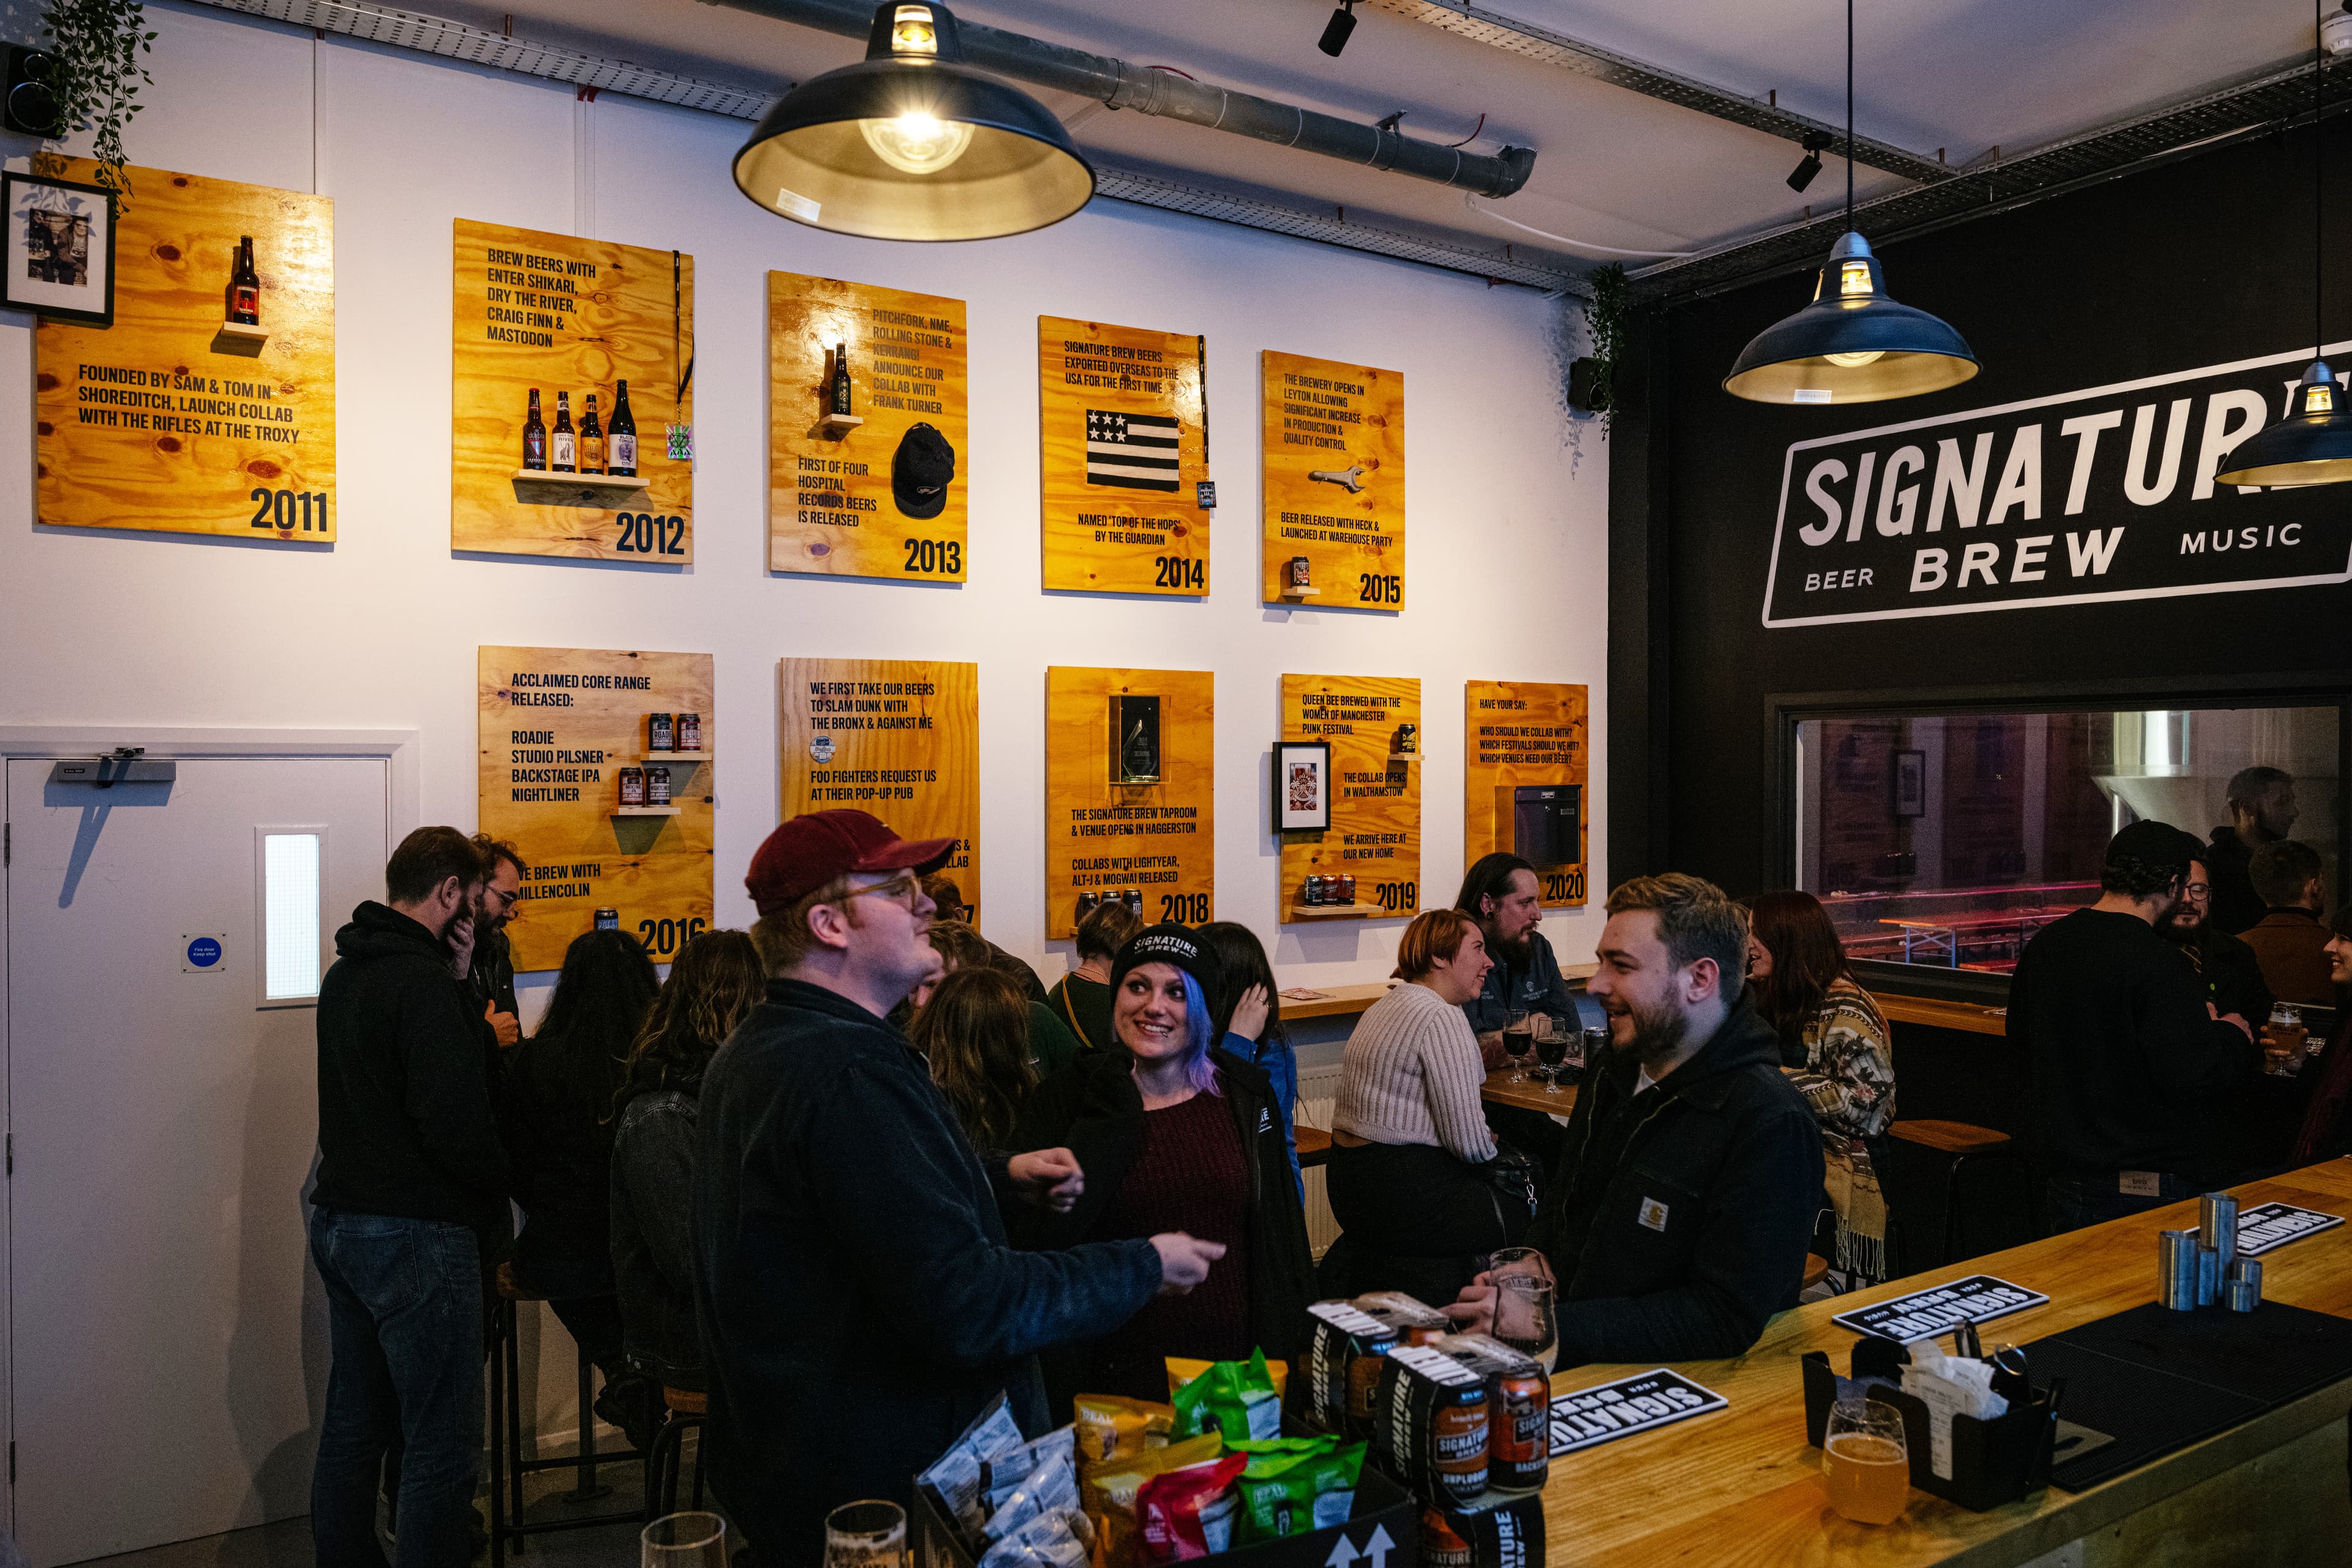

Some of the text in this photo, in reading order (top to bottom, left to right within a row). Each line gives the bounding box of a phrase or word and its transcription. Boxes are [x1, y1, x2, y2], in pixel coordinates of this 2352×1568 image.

[488, 248, 595, 278] BREW BEERS WITH
[488, 268, 578, 296] ENTER SHIKARI,
[488, 287, 577, 314] DRY THE RIVER,
[488, 307, 564, 330] CRAIG FINN &
[488, 326, 552, 347] MASTODON
[1065, 341, 1162, 362] SIGNATURE BREW BEERS
[1065, 357, 1178, 380] EXPORTED OVERSEAS TO THE
[79, 364, 271, 399] FOUNDED BY SAM & TOM IN
[873, 378, 935, 396] COLLAB WITH
[1284, 374, 1364, 396] THE BREWERY OPENS IN
[79, 386, 293, 423] SHOREDITCH, LAUNCH COLLAB
[873, 395, 942, 414] FRANK TURNER
[1284, 388, 1348, 407] LEYTON ALLOWING
[1284, 403, 1360, 424] SIGNIFICANT INCREASE
[79, 408, 299, 444] WITH THE RIFLES AT THE TROXY
[1284, 432, 1346, 450] QUALITY CONTROL
[799, 458, 868, 476] FIRST OF FOUR
[799, 475, 845, 492] HOSPITAL
[251, 488, 327, 532] 2011
[799, 493, 876, 511] RECORDS BEERS
[799, 511, 858, 527] IS RELEASED
[617, 512, 685, 554] 2012
[1095, 530, 1165, 546] BY THE GUARDIAN
[905, 538, 960, 573] 2013
[1805, 523, 2302, 592] BEER BREW MUSIC
[1156, 557, 1204, 588] 2014
[1360, 574, 1400, 603] 2015
[512, 673, 650, 689] ACCLAIMED CORE RANGE
[810, 682, 934, 695] WE FIRST TAKE OUR BEERS
[512, 692, 573, 707] RELEASED:
[811, 700, 907, 712] TO SLAM DUNK WITH
[1480, 699, 1527, 710] HAVE YOUR SAY:
[1303, 709, 1385, 722] WOMEN OF MANCHESTER
[512, 731, 554, 744] ROADIE
[1303, 724, 1354, 735] PUNK FESTIVAL
[512, 750, 604, 763] STUDIO PILSNER
[1480, 754, 1571, 764] WHICH VENUES NEED OUR BEER?
[512, 769, 600, 783] BACKSTAGE IPA
[811, 771, 936, 783] FOO FIGHTERS REQUEST US
[1344, 772, 1406, 783] THE COLLAB OPENS
[512, 788, 579, 802] NIGHTLINER
[1344, 786, 1403, 797] IN WALTHAMSTOW
[1072, 807, 1196, 821] THE SIGNATURE BREW TAPROOM
[1072, 856, 1179, 870] COLLABS WITH LIGHTYEAR,
[1344, 848, 1393, 859] OUR NEW HOME
[534, 865, 567, 880] BREW
[571, 864, 600, 878] WITH
[1376, 882, 1415, 910] 2019
[1547, 873, 1583, 900] 2020
[1161, 894, 1208, 924] 2018
[639, 918, 704, 956] 2016
[1135, 935, 1198, 957] SIGNATURE
[1891, 1290, 1961, 1314] BREW
[1872, 1287, 2029, 1338] SIGNATURE
[1550, 1387, 1703, 1449] SIGNATU
